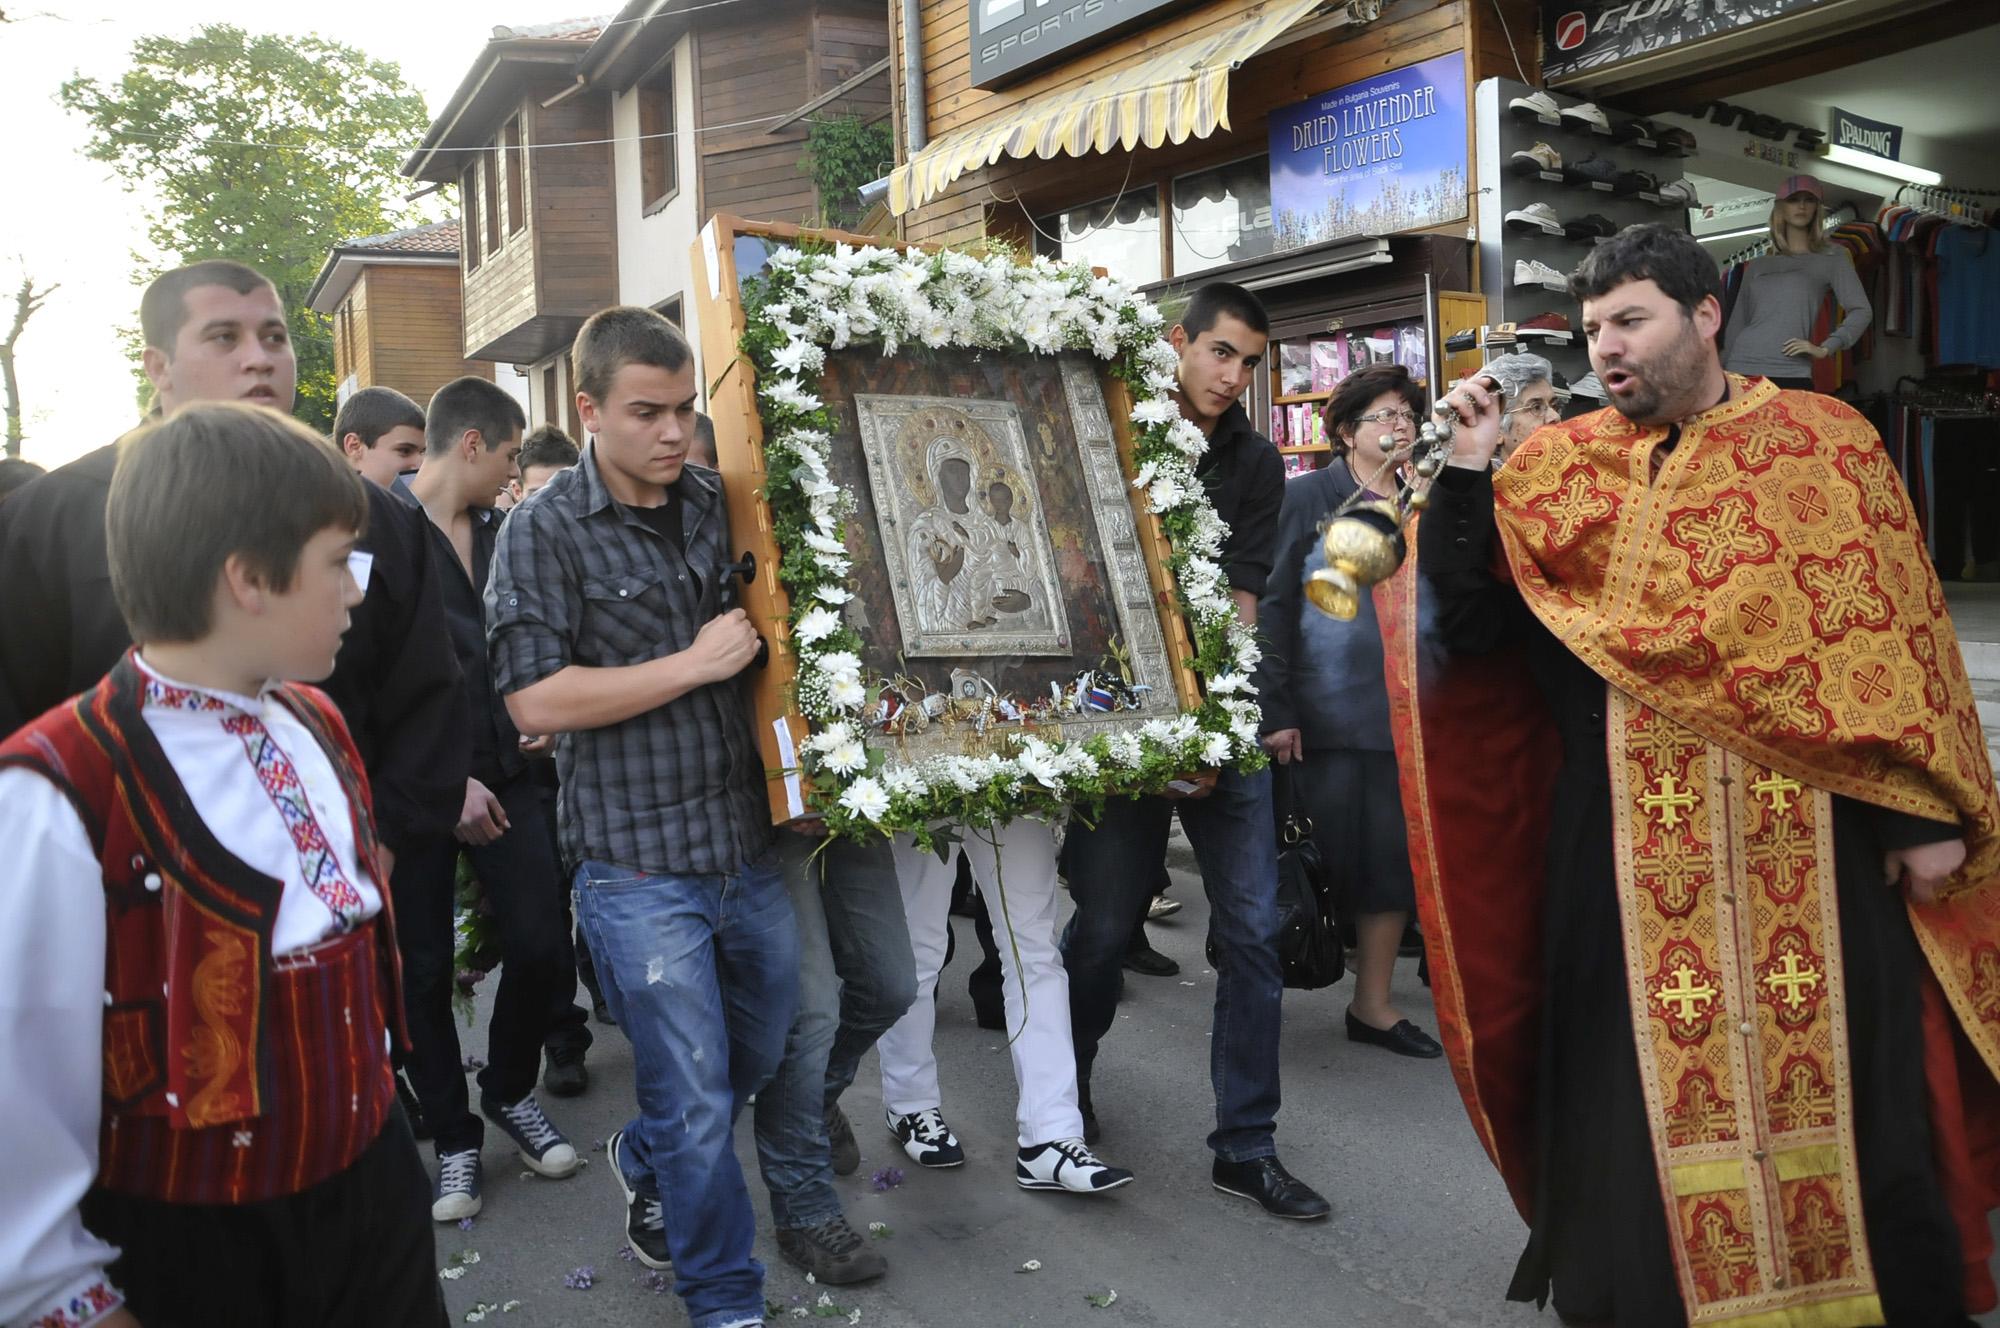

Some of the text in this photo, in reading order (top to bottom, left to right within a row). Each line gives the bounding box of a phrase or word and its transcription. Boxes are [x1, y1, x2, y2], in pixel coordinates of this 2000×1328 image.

[980, 0, 1104, 64] SPORTS
[1292, 85, 1436, 152] DRIED LAVENDER
[1321, 100, 1337, 111] Made
[1345, 90, 1369, 104] Bulgaria
[1370, 81, 1401, 97] Souvenirs
[1323, 128, 1403, 175] FLOWERS
[1839, 118, 1891, 157] SPALDING
